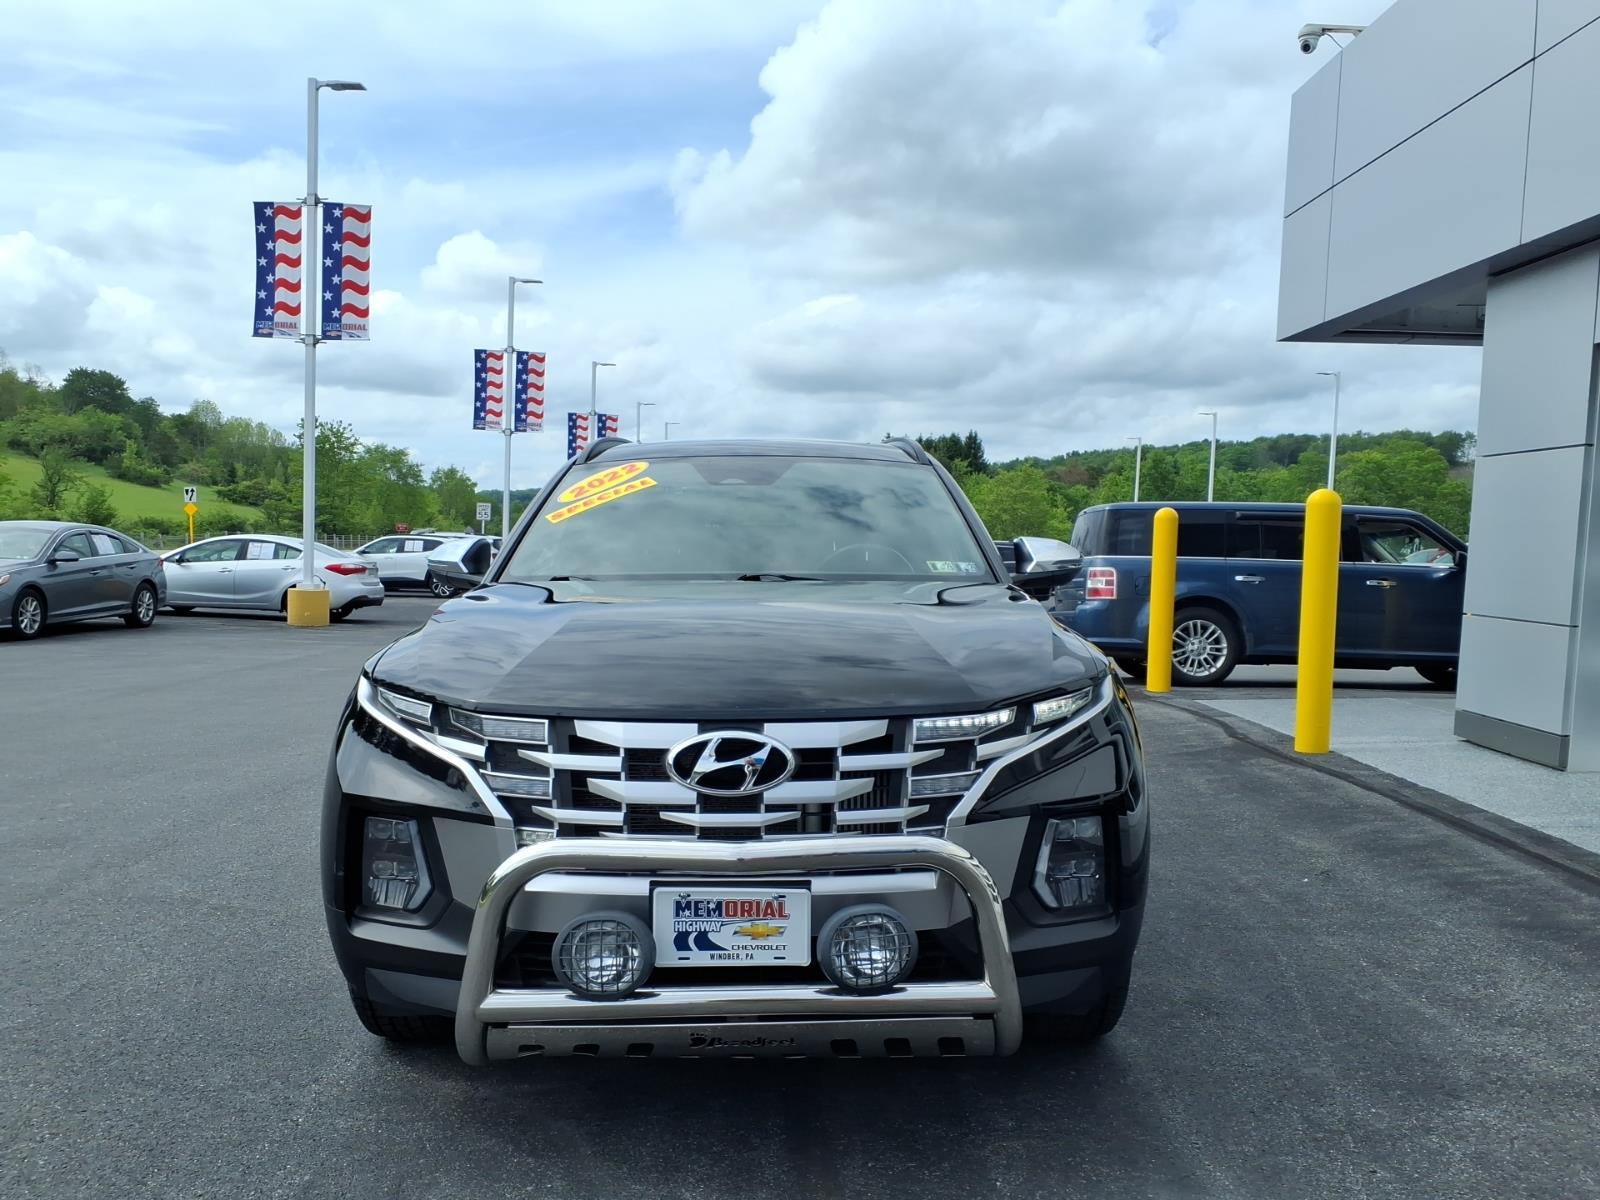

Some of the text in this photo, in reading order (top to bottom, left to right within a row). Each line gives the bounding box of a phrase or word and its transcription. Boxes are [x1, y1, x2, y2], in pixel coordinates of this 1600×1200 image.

[569, 464, 641, 498] 2022
[551, 479, 650, 520] SPECIAL
[673, 898, 790, 920] MEMORIAL
[674, 921, 722, 932] HIGHWAY
[709, 952, 754, 961] WINDBER, PA
